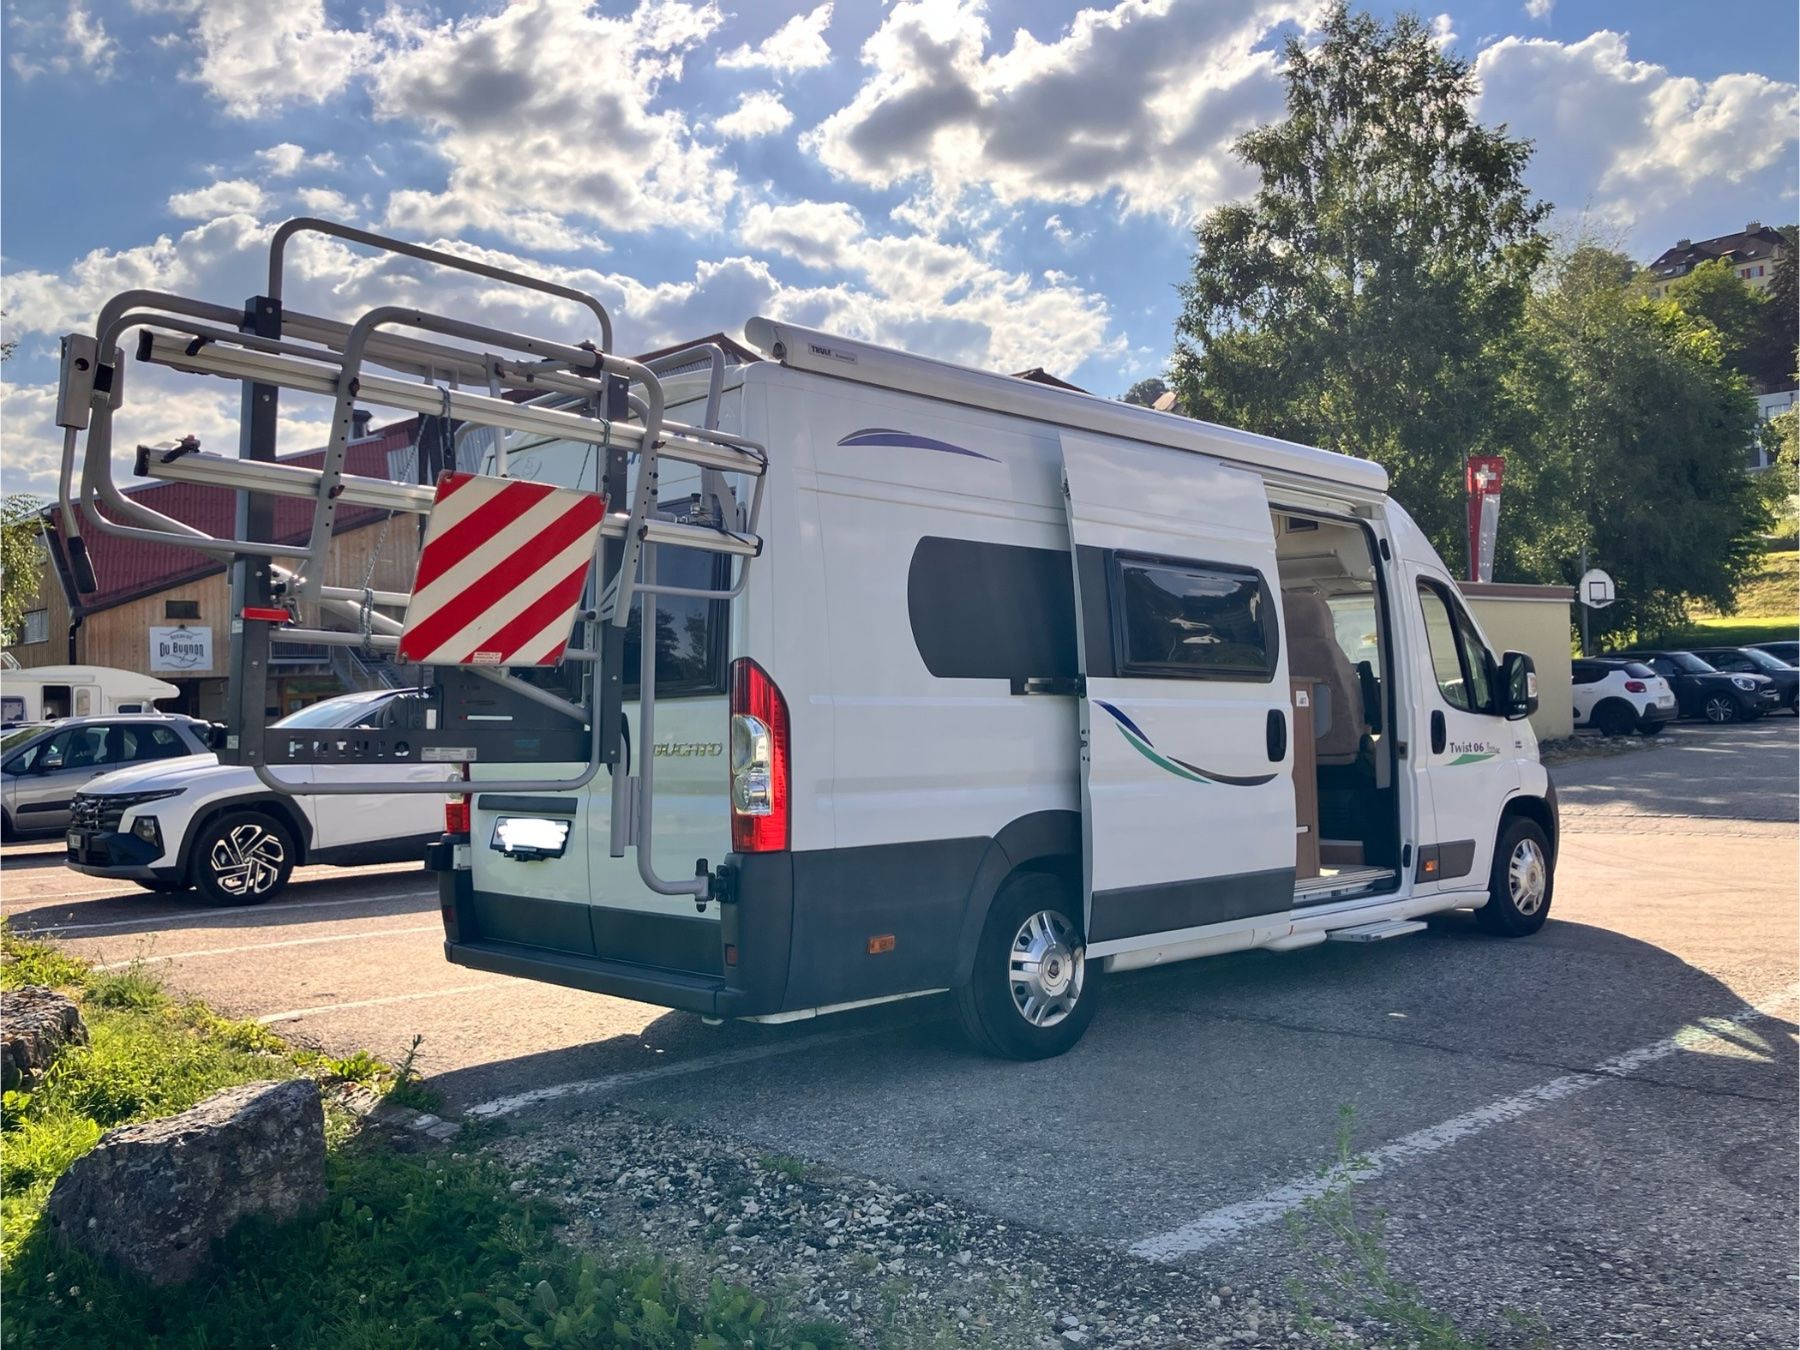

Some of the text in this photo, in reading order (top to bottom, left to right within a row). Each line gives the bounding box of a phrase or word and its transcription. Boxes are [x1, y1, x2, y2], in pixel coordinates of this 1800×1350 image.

[810, 344, 832, 357] THULE
[159, 642, 204, 657] Du Bugnon
[1449, 742, 1472, 754] Twist
[1473, 742, 1485, 753] 06
